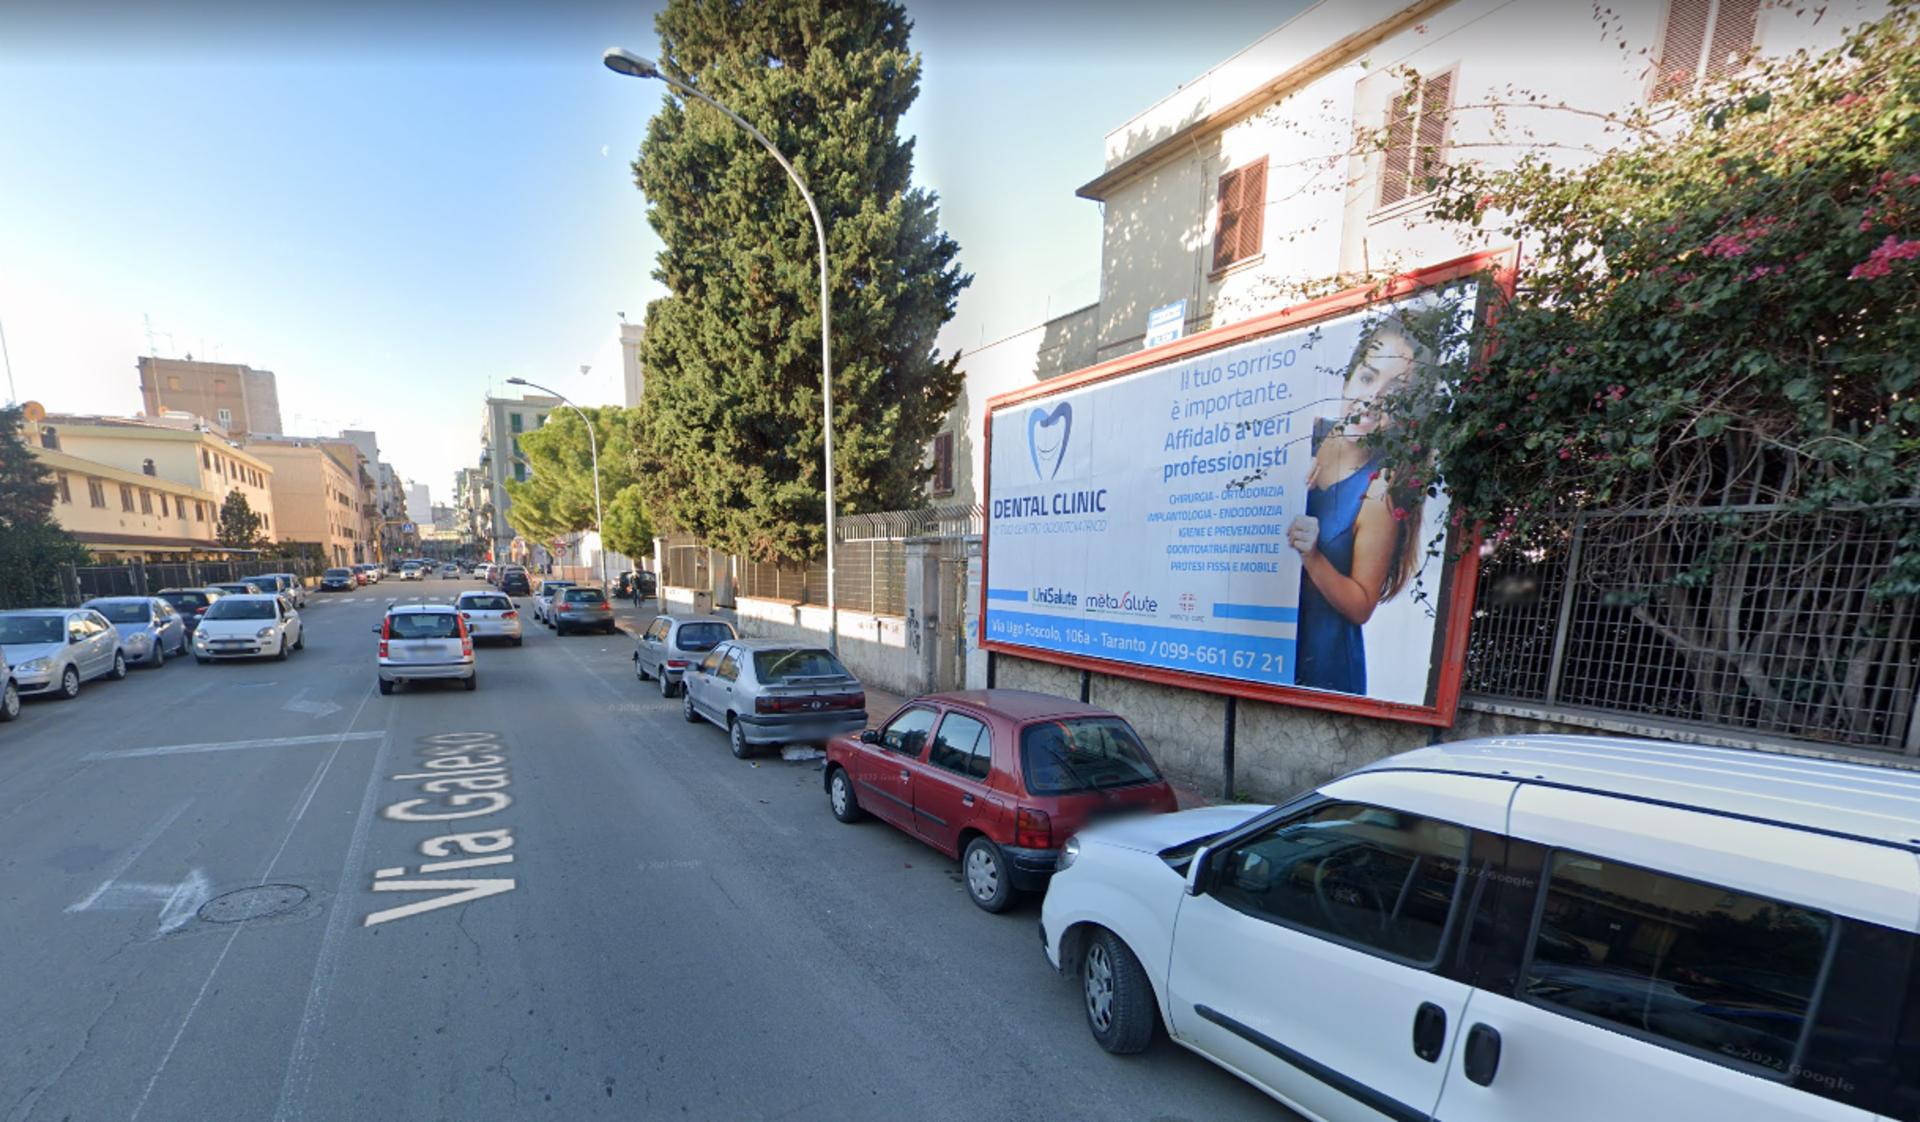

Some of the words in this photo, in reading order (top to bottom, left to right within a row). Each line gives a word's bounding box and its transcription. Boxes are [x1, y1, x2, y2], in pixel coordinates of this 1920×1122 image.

[1180, 370, 1190, 391] Il
[1193, 366, 1222, 388] tuo
[1227, 348, 1297, 380] sorriso
[1170, 400, 1181, 420] è
[1184, 381, 1293, 420] importante.
[1235, 424, 1246, 441] a
[1252, 417, 1291, 438] veri
[1163, 446, 1288, 483] professionisti
[994, 495, 1049, 519] DENTAL
[1052, 488, 1107, 515] CLINIC
[1169, 491, 1214, 505] CHIRURGIA
[1220, 485, 1284, 501] ORTODONZIA
[1147, 509, 1212, 523] IMPLANTOLOGIA
[1219, 505, 1282, 520] ENDODONZIA
[1178, 527, 1206, 538] IGIENE
[1215, 524, 1282, 537] PREVENZIONE
[1229, 543, 1280, 555] INFANTILE
[1170, 561, 1206, 572] PROTESI
[1206, 561, 1231, 572] FISSA
[1240, 562, 1279, 573] MOBILE
[1032, 587, 1077, 606] UniSalute
[991, 619, 1005, 633] Via
[1006, 621, 1023, 637] Ugo
[1025, 623, 1061, 643] Foscolo,
[1065, 629, 1090, 644] 106a
[1101, 632, 1146, 653] Taranto
[1159, 640, 1227, 666] 099-661
[1233, 650, 1256, 669] 67
[1261, 652, 1285, 673] 21
